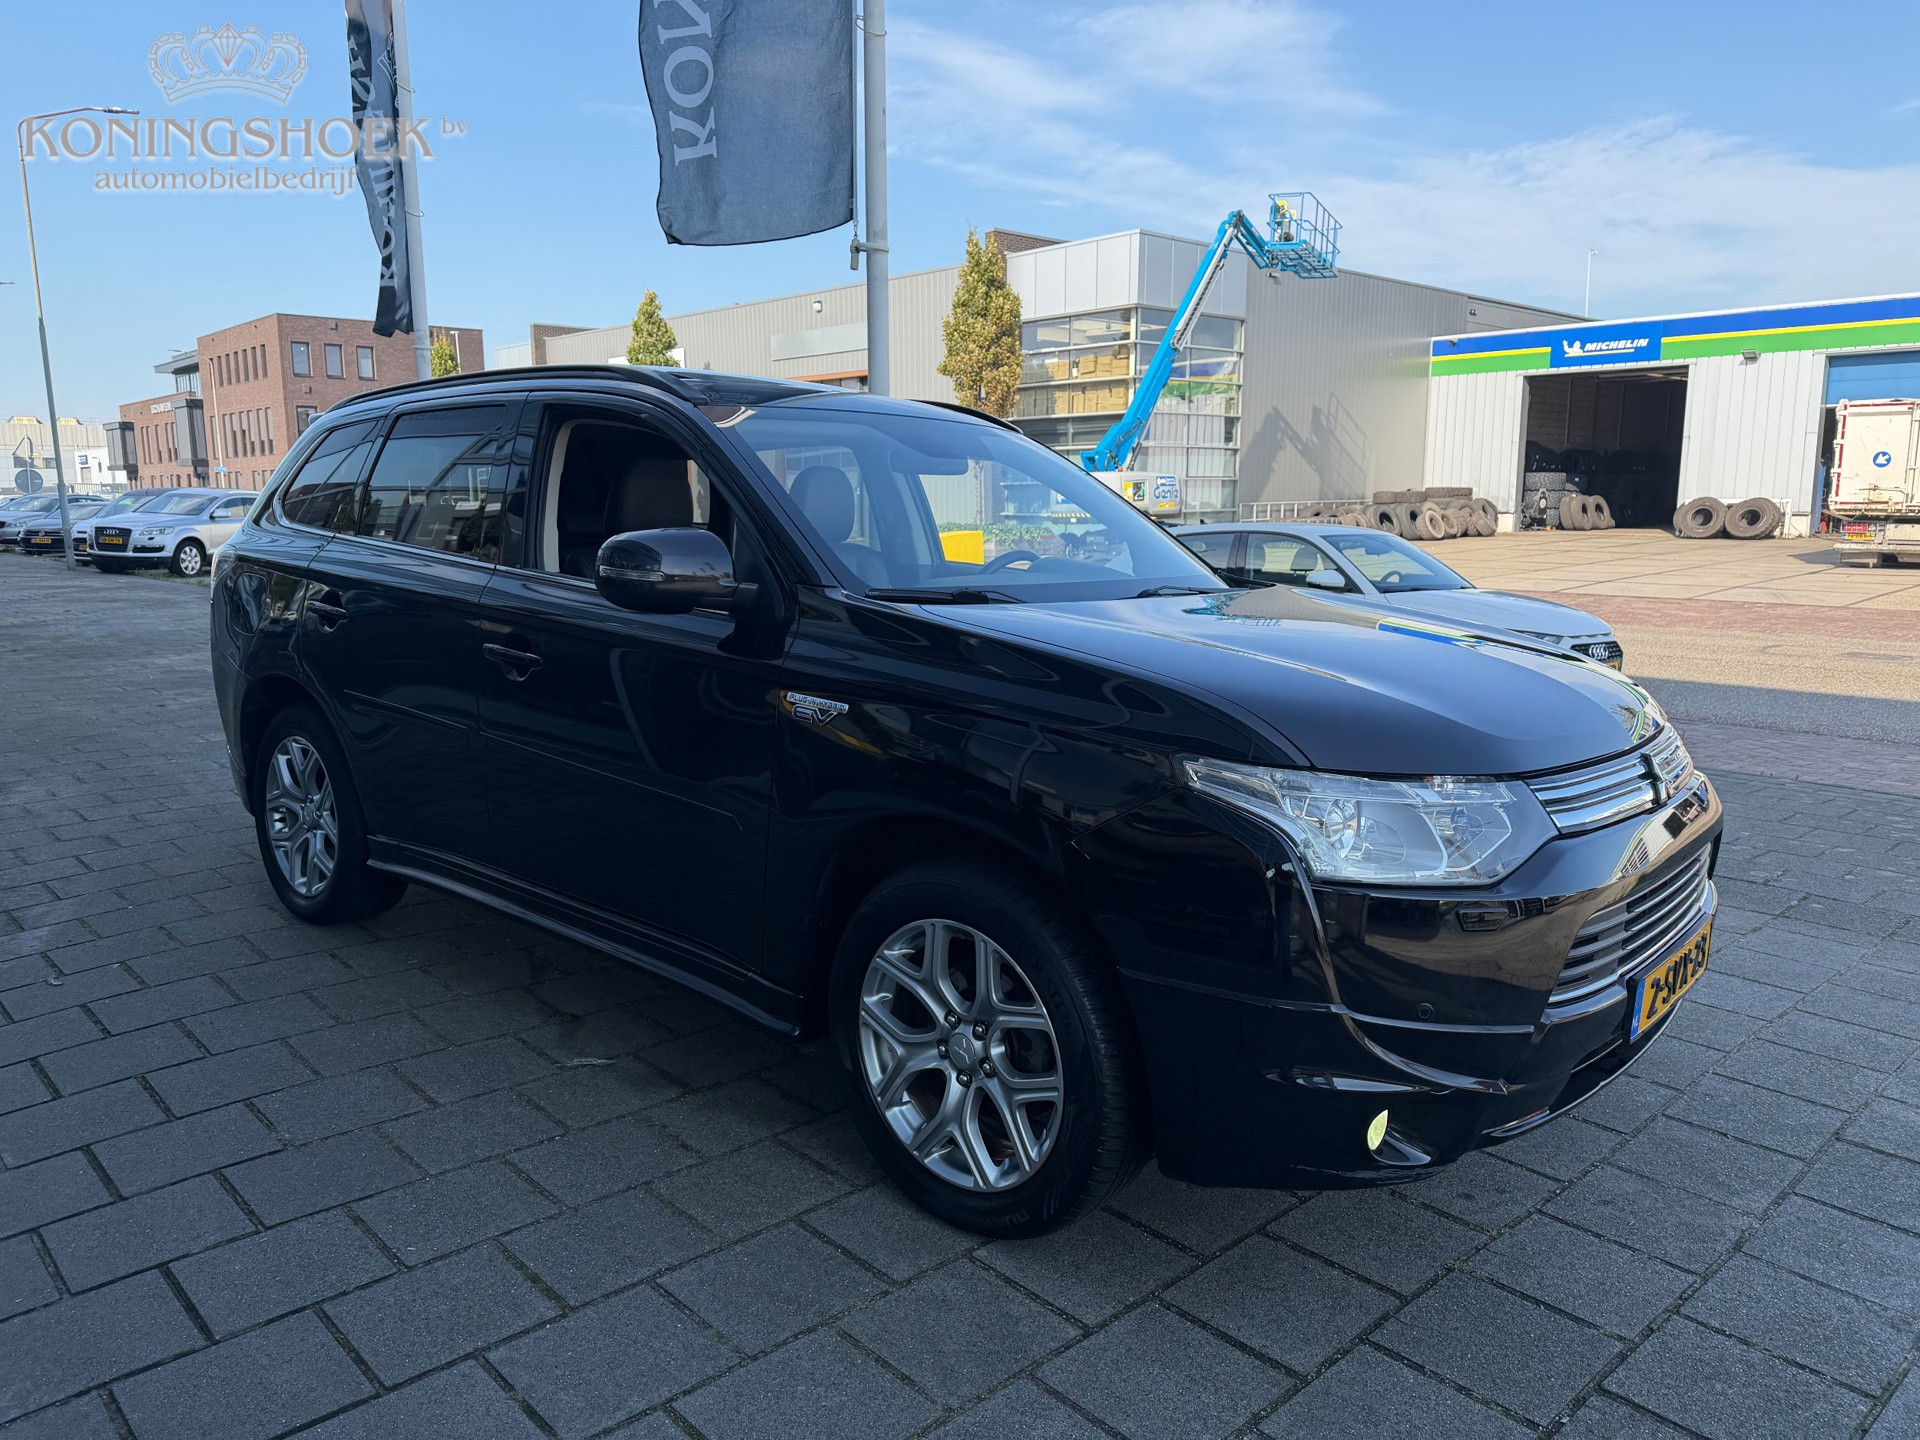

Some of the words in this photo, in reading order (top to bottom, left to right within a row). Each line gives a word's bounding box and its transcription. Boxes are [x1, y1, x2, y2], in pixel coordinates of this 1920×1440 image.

[1583, 338, 1649, 352] MICHELIN
[1153, 486, 1179, 499] Genie
[792, 703, 838, 725] EV
